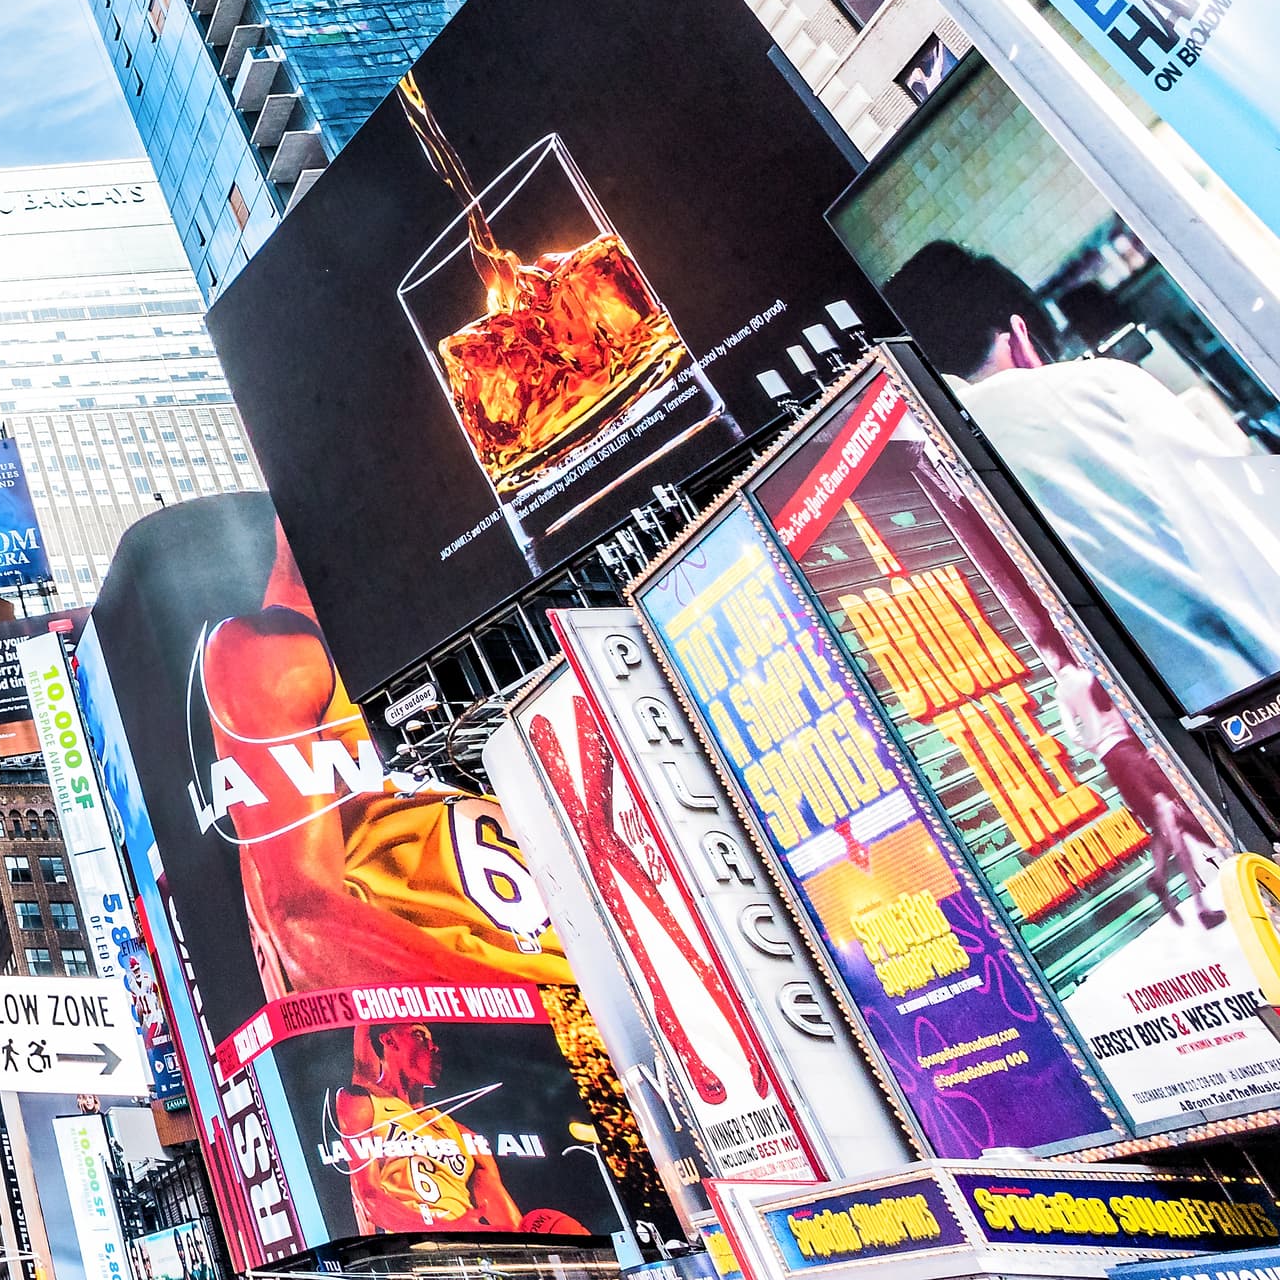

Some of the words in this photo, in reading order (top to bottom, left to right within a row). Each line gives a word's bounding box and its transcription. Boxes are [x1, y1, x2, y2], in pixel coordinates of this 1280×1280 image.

[1153, 61, 1184, 92] ON
[24, 186, 146, 211] BARCLAYS
[842, 497, 903, 576] A
[673, 622, 731, 702] NOT
[723, 565, 798, 668] JUST
[839, 566, 1031, 723] BRONX
[43, 665, 83, 769] 10,000
[70, 776, 94, 810] SF
[390, 705, 404, 719] city
[404, 689, 431, 711] outdoor
[744, 706, 901, 848] SPONGE
[933, 681, 1108, 856] TALE
[603, 632, 836, 1042] PALACE
[48, 996, 115, 1028] ZONE
[280, 991, 354, 1033] HERSHEY'S
[352, 988, 460, 1021] CHOCOLATE
[465, 988, 536, 1019] WORLD
[1092, 1031, 1140, 1060] JERSEY
[1139, 1016, 1178, 1047] BOYS
[1171, 1013, 1190, 1036] &
[1184, 1000, 1230, 1033] WEST
[1229, 991, 1260, 1022] SIDE
[319, 1141, 350, 1165] LA
[357, 1135, 458, 1161] Wants
[465, 1135, 493, 1157] It
[497, 1133, 546, 1158] All
[706, 1117, 746, 1151] WINNER!
[745, 1121, 755, 1140] 6
[751, 1108, 775, 1137] TONY
[76, 1128, 99, 1192] 10,000
[94, 1195, 107, 1218] SF
[972, 1188, 1112, 1235] SPONGEBOB
[1110, 1194, 1279, 1238] SQUAREPANTS
